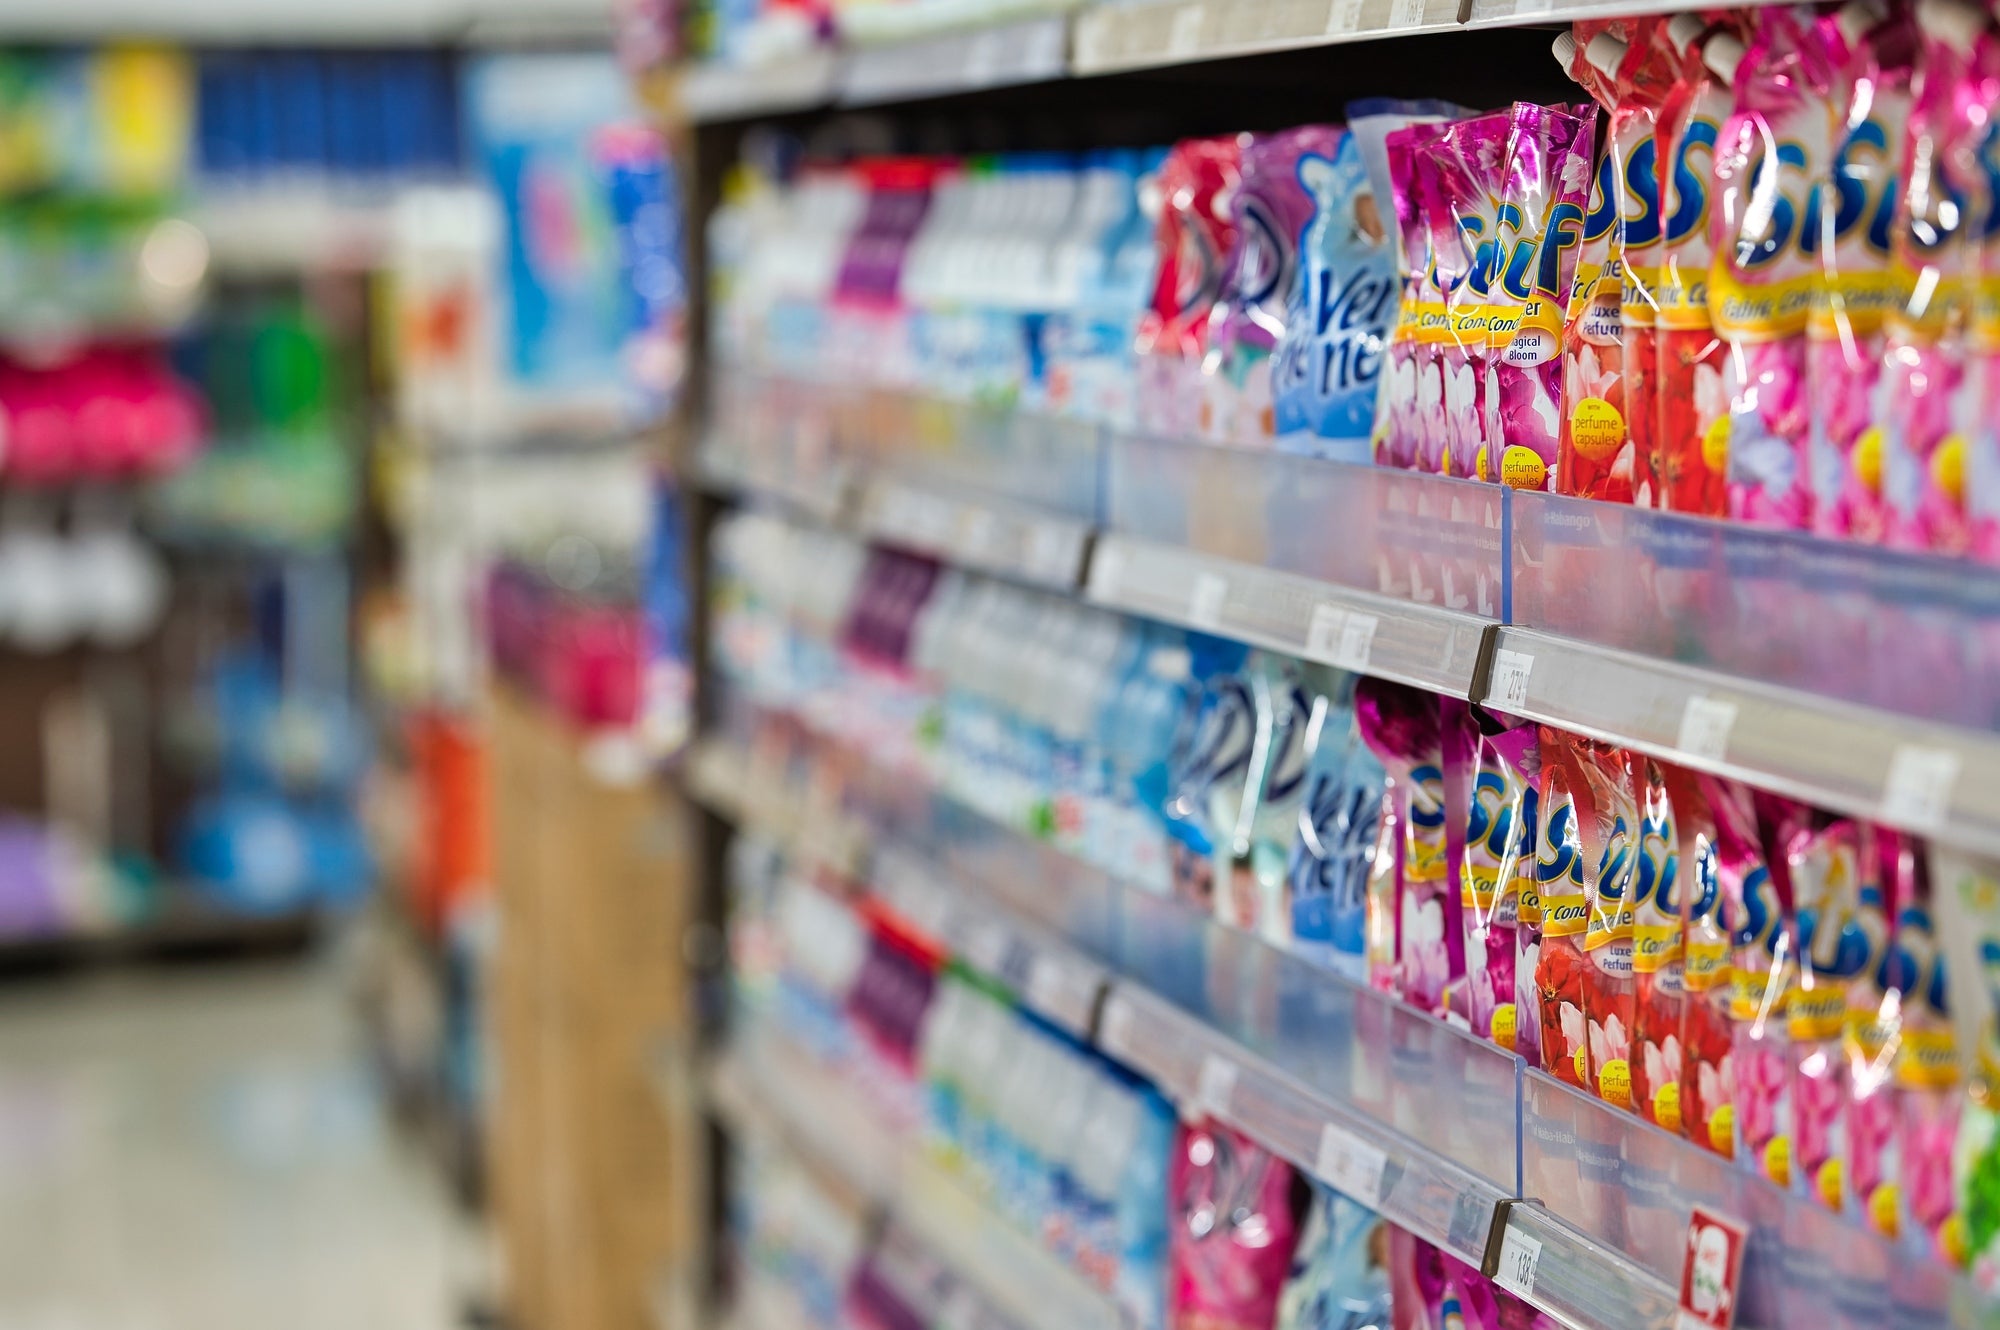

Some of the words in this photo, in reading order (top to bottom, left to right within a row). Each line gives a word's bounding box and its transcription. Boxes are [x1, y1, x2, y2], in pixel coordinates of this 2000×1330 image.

[1512, 335, 1541, 349] agical
[1509, 350, 1537, 361] Bloom
[1575, 415, 1618, 431] perfume
[1575, 432, 1618, 447] capsules
[1504, 461, 1540, 476] perfume
[1504, 475, 1539, 490] capsules
[1610, 945, 1631, 957] Luxe
[1516, 1250, 1532, 1286] 138
